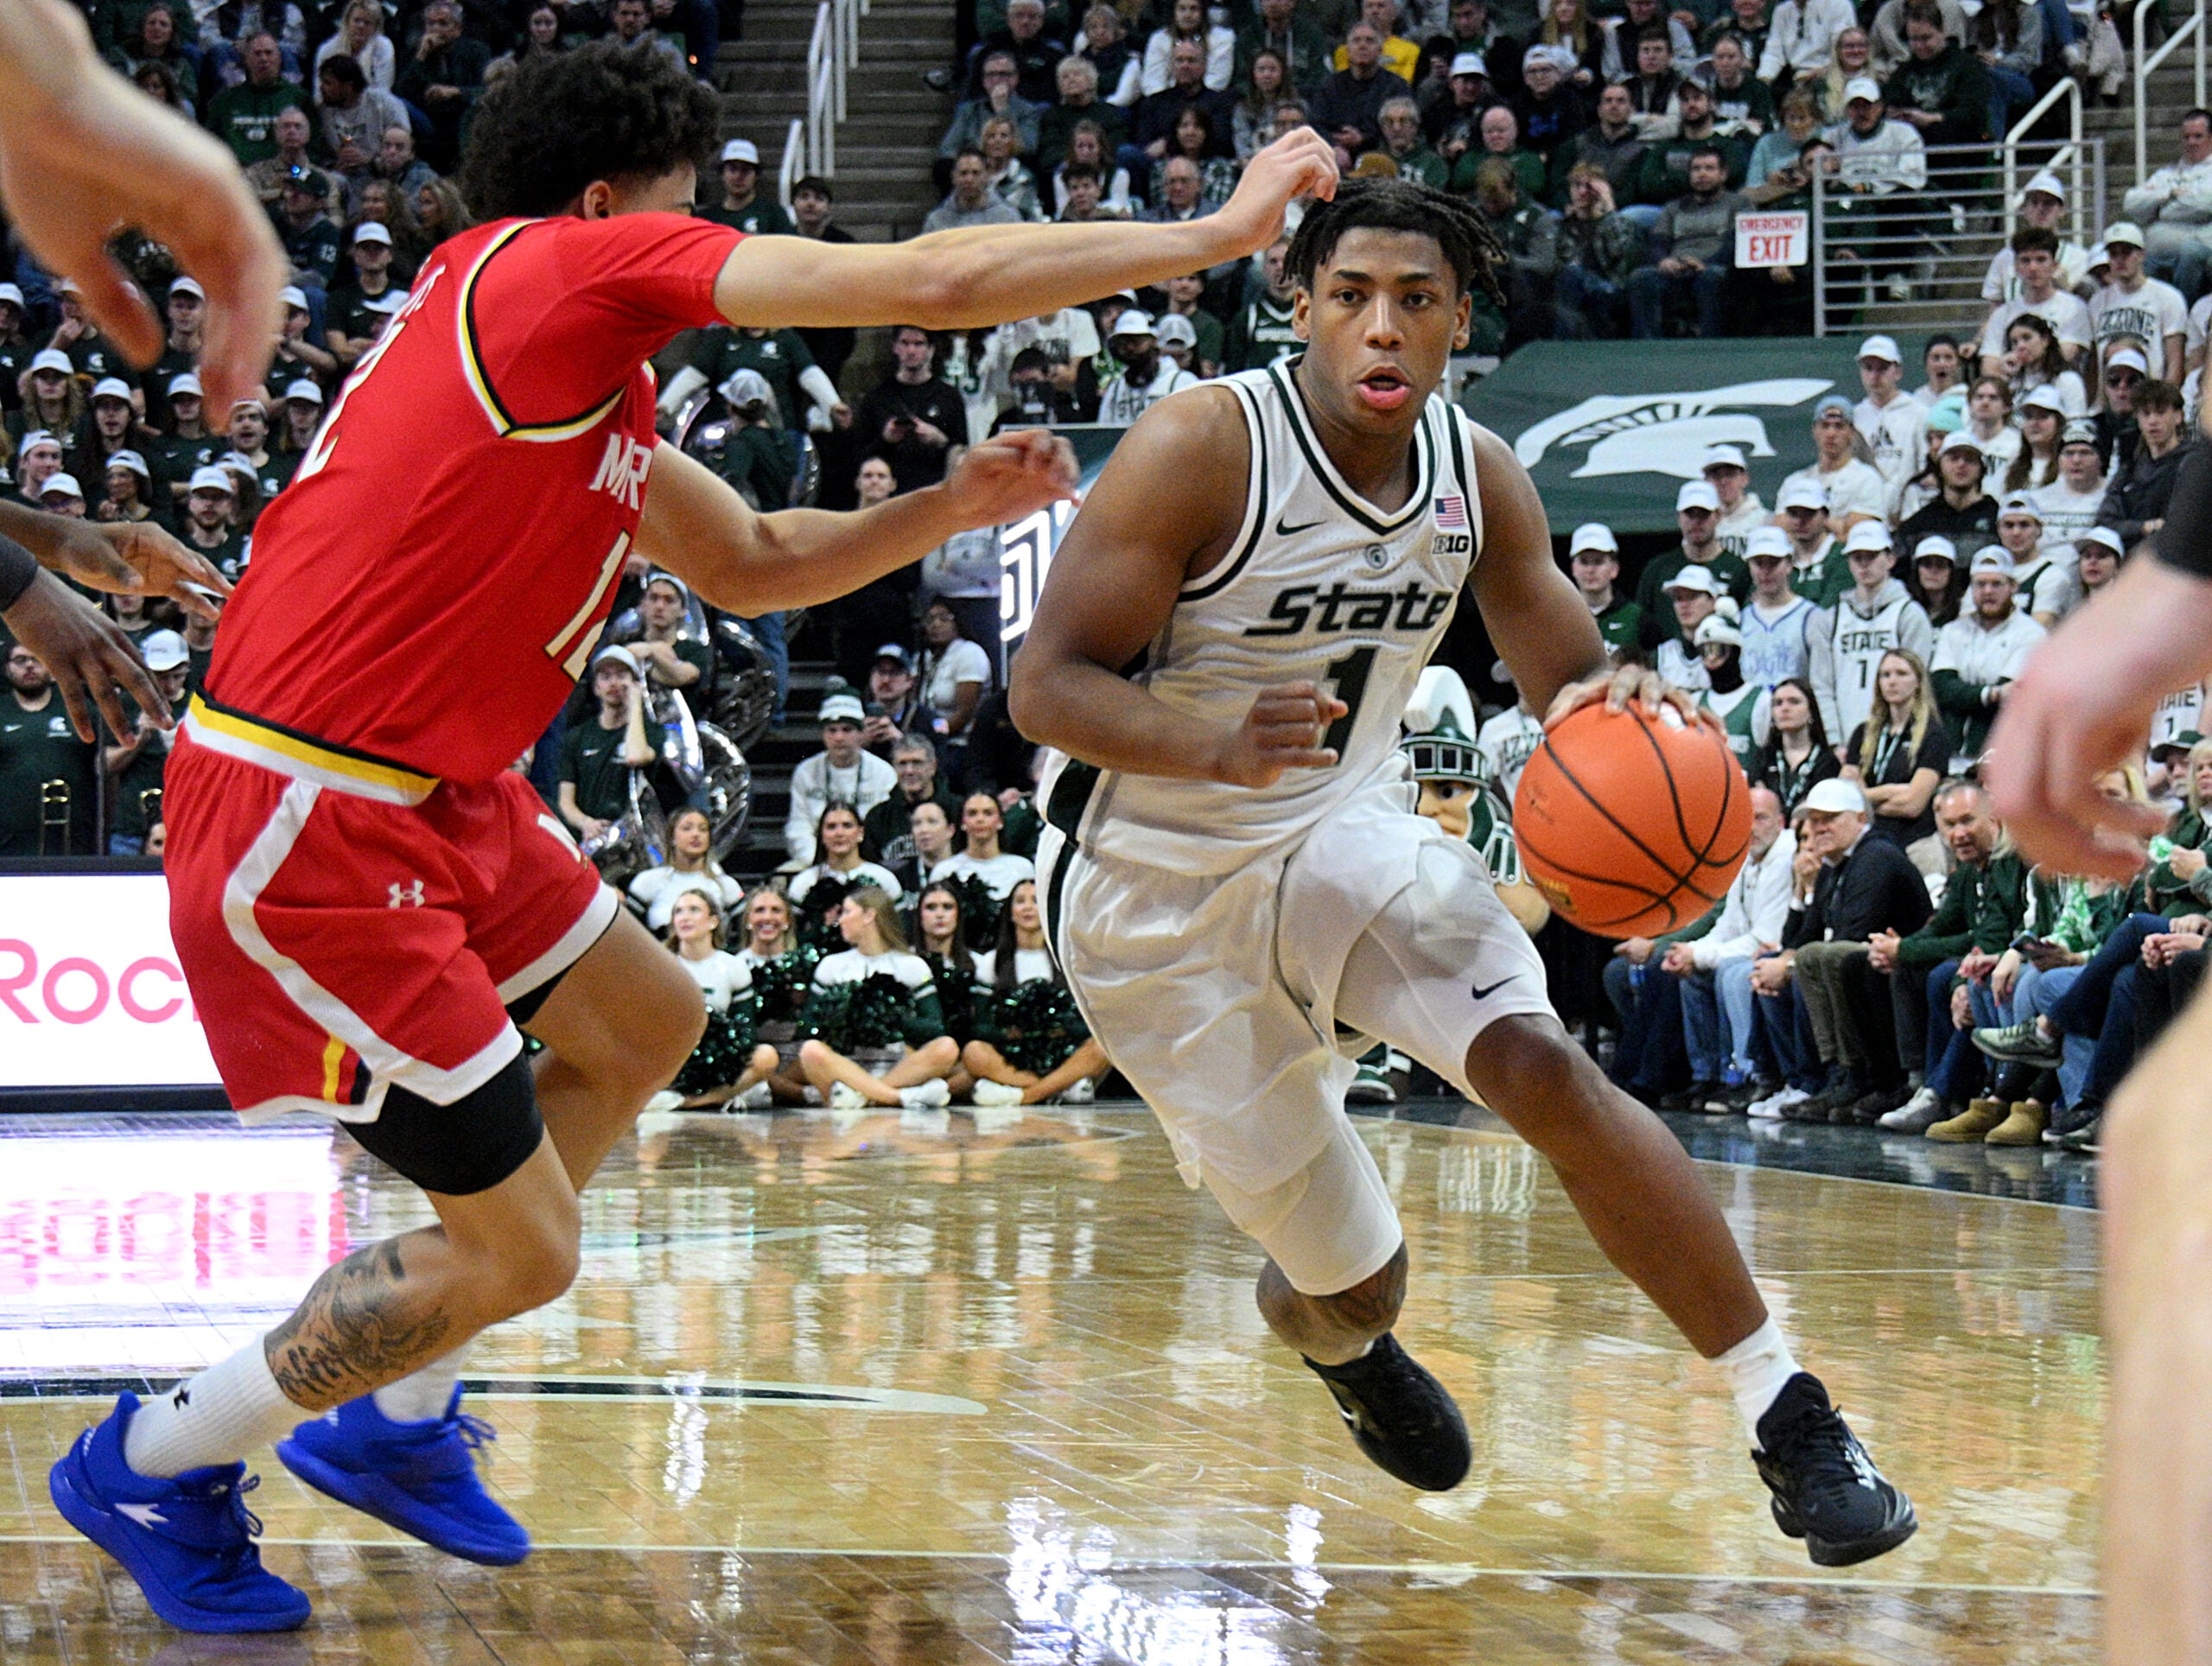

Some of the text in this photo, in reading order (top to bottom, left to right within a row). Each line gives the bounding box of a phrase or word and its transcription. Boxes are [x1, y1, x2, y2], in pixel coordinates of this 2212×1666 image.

[1750, 235, 1792, 262] EXIT
[1241, 581, 1454, 637] State
[1840, 629, 1891, 654] STATE
[1859, 659, 1867, 689] 1
[1322, 645, 1382, 766] 1
